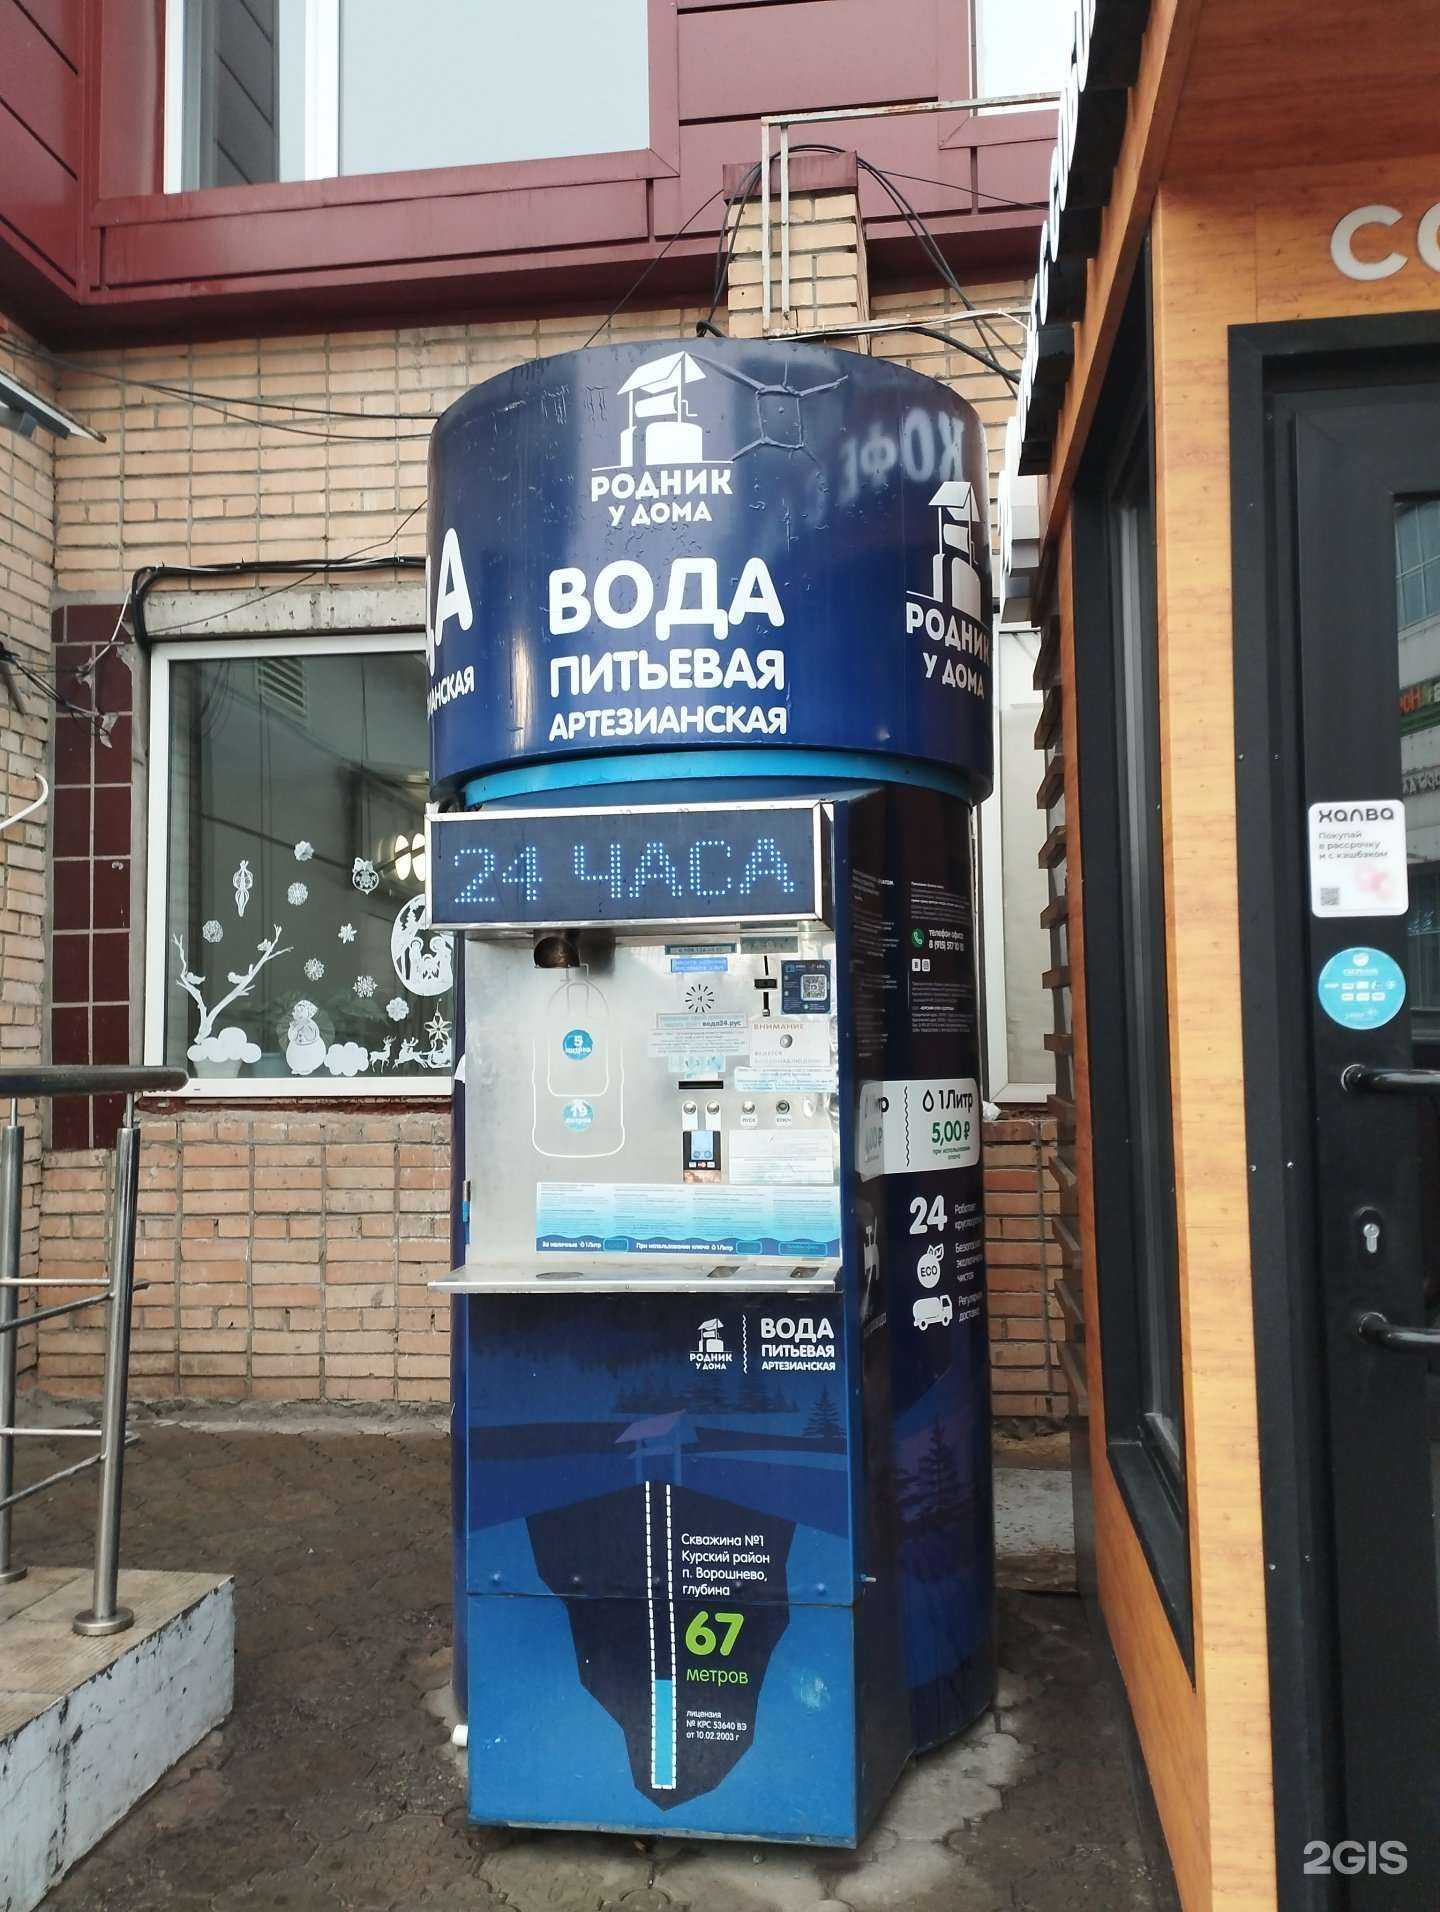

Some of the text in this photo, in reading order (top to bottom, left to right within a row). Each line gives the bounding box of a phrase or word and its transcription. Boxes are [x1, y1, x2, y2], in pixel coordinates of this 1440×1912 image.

[591, 468, 734, 502] РОДНИК
[608, 500, 713, 528] У ДОМА
[426, 527, 473, 677] А
[547, 556, 786, 642] ВОДА
[549, 647, 786, 699] ПИТЬЕВАЯ
[923, 652, 985, 700] У ДОМА
[548, 703, 788, 742] АРТЕЗИАНСКАЯ
[1318, 831, 1362, 841] Покупай
[454, 845, 543, 903] 24
[573, 837, 796, 900] ЧАСА
[909, 1194, 948, 1235] 24
[920, 1266, 938, 1277] ECO
[760, 1317, 835, 1343] ВОДА
[689, 1353, 733, 1362] РОДНИК
[761, 1344, 835, 1358] ПИТЬЕВАЯ
[695, 1362, 727, 1370] У ДОМА
[761, 1361, 836, 1371] АРТЕЗИАНСКАЯ
[681, 1533, 742, 1546] Скважина
[682, 1549, 770, 1566] Курский район
[682, 1567, 768, 1581] п. Ворошнево,
[682, 1584, 730, 1597] глубина
[685, 1610, 744, 1657] 67
[686, 1668, 749, 1687] метров
[686, 1710, 722, 1719] лицензия
[697, 1720, 712, 1730] КРС
[696, 1731, 734, 1741] 10.02.2003
